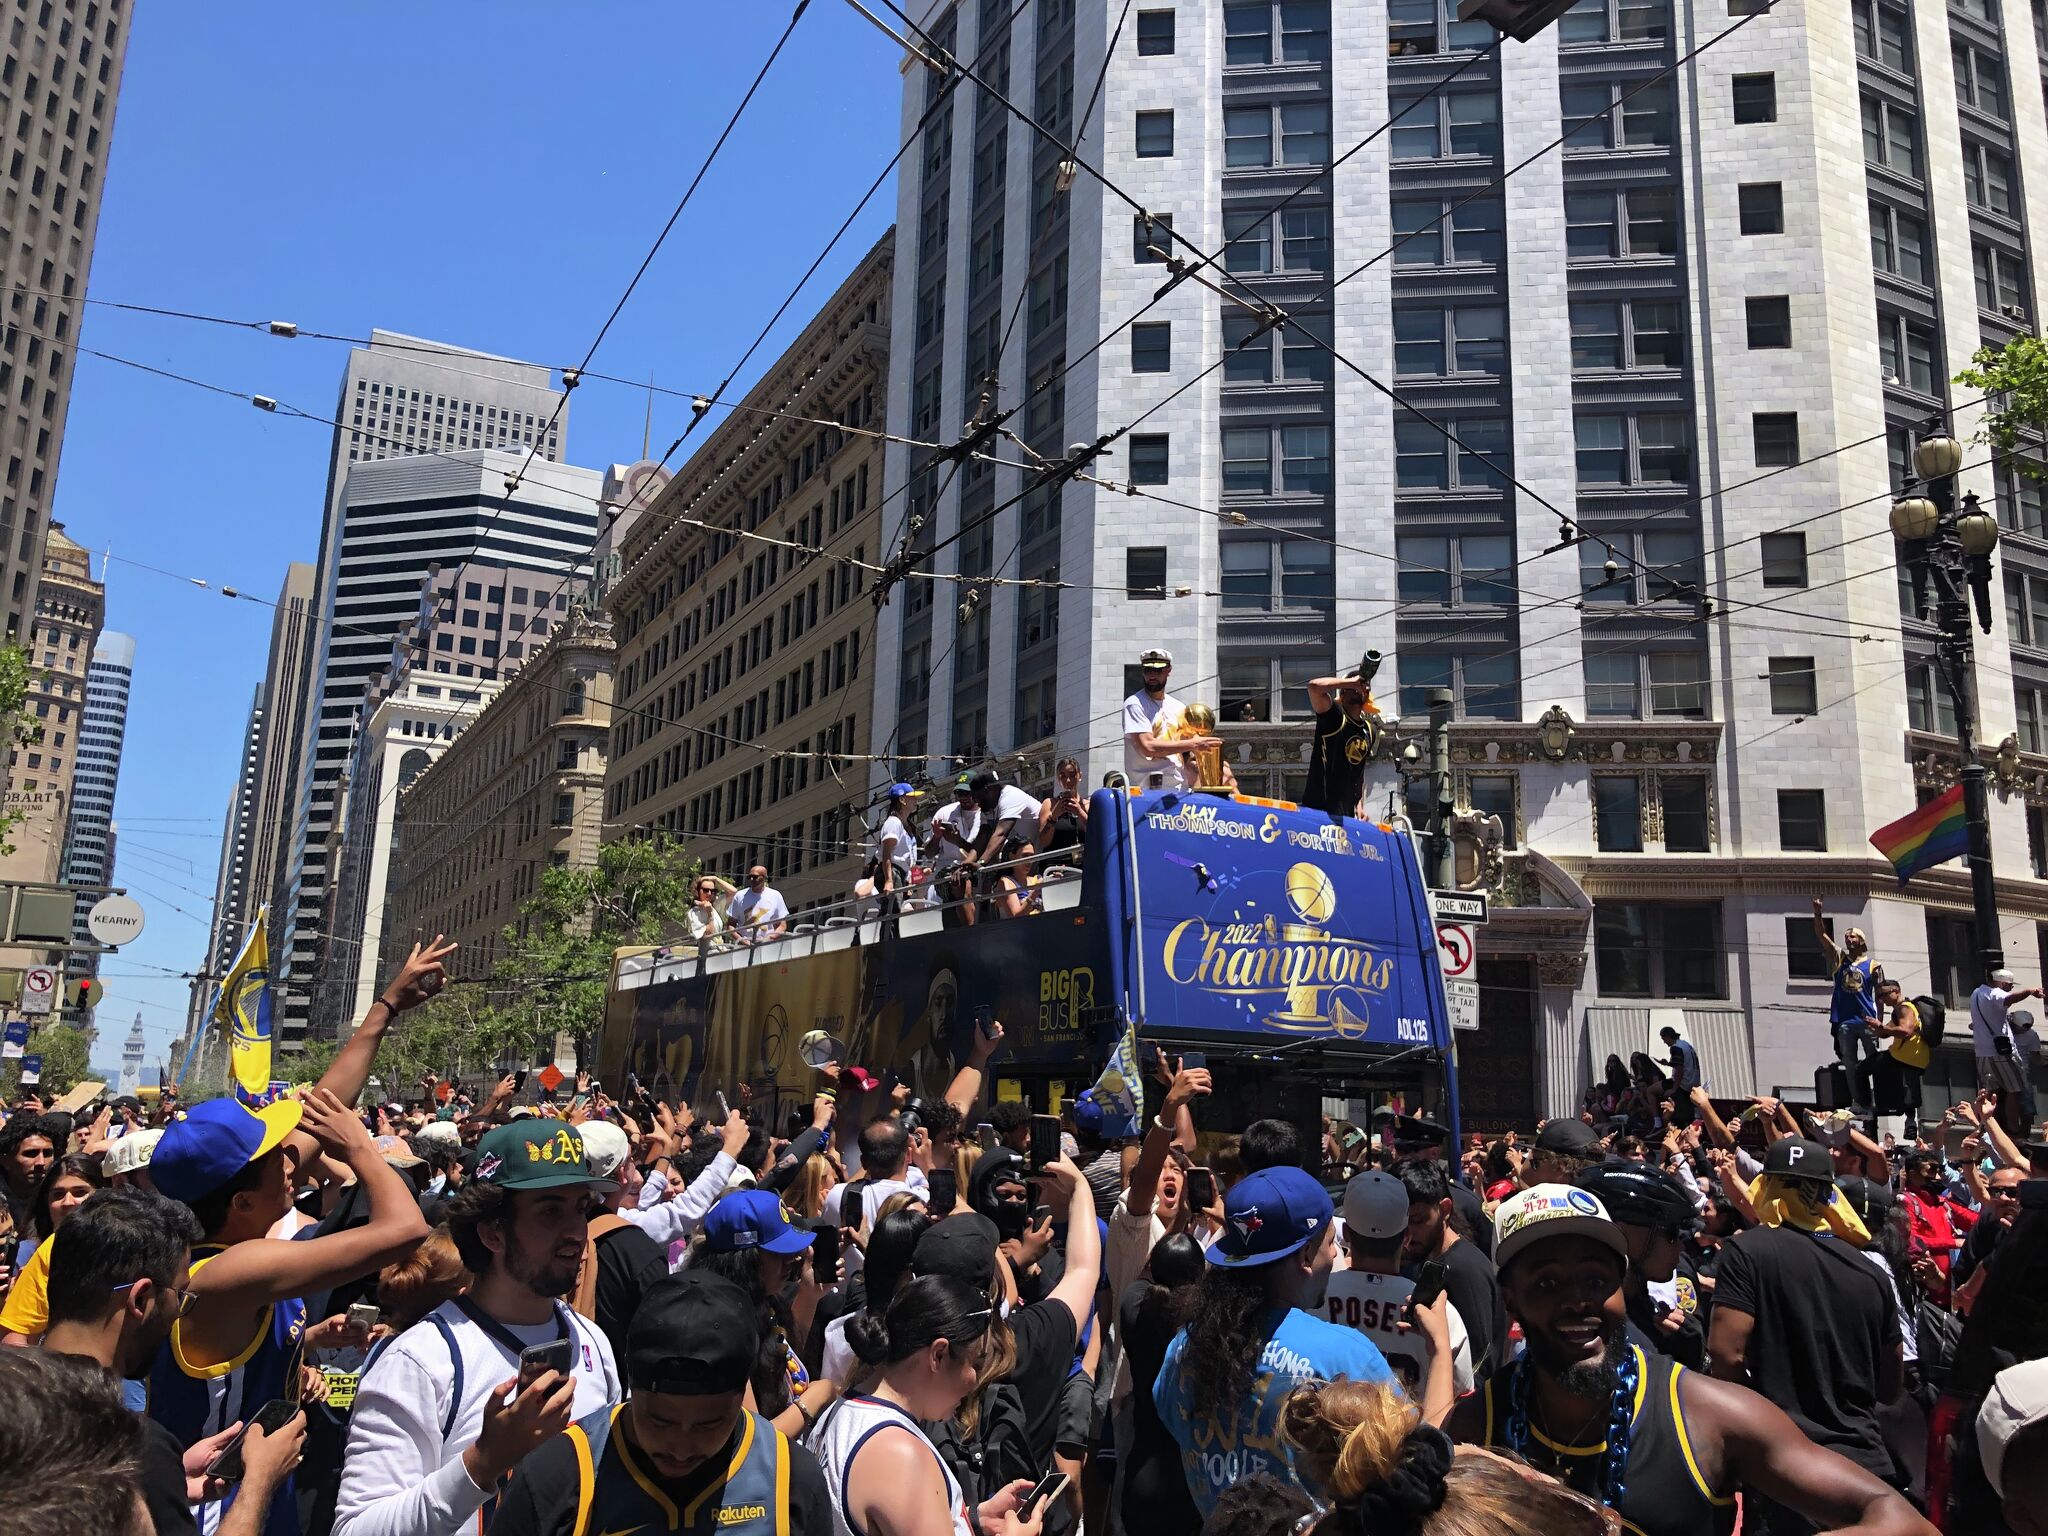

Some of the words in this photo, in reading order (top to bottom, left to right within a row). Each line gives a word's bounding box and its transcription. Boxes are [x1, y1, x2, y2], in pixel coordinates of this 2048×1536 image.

[1181, 803, 1217, 824] KLAY
[1145, 812, 1256, 840] THOMPSON
[1260, 813, 1281, 844] &
[1287, 830, 1355, 857] PORTER
[1359, 844, 1384, 862] JR.
[1320, 824, 1347, 839] OTTO
[1435, 899, 1455, 912] ONE
[1459, 901, 1479, 914] WAY
[94, 914, 139, 927] KEARNY
[1222, 923, 1263, 945] 2022
[1163, 915, 1394, 1004] Champions
[1040, 969, 1070, 1002] BIG
[1458, 984, 1476, 995] MUNI
[1449, 1006, 1462, 1014] OM
[1460, 998, 1475, 1008] TAXI
[1039, 1002, 1069, 1031] BUS
[1397, 1017, 1428, 1041] ADL125
[1468, 1120, 1519, 1131] BUILDING
[552, 1129, 583, 1165] A's
[1788, 1146, 1804, 1166] P
[1522, 1192, 1540, 1203] The
[1524, 1198, 1549, 1214] 21-22
[1550, 1197, 1569, 1208] NBA
[712, 1504, 766, 1523] Rakuten
